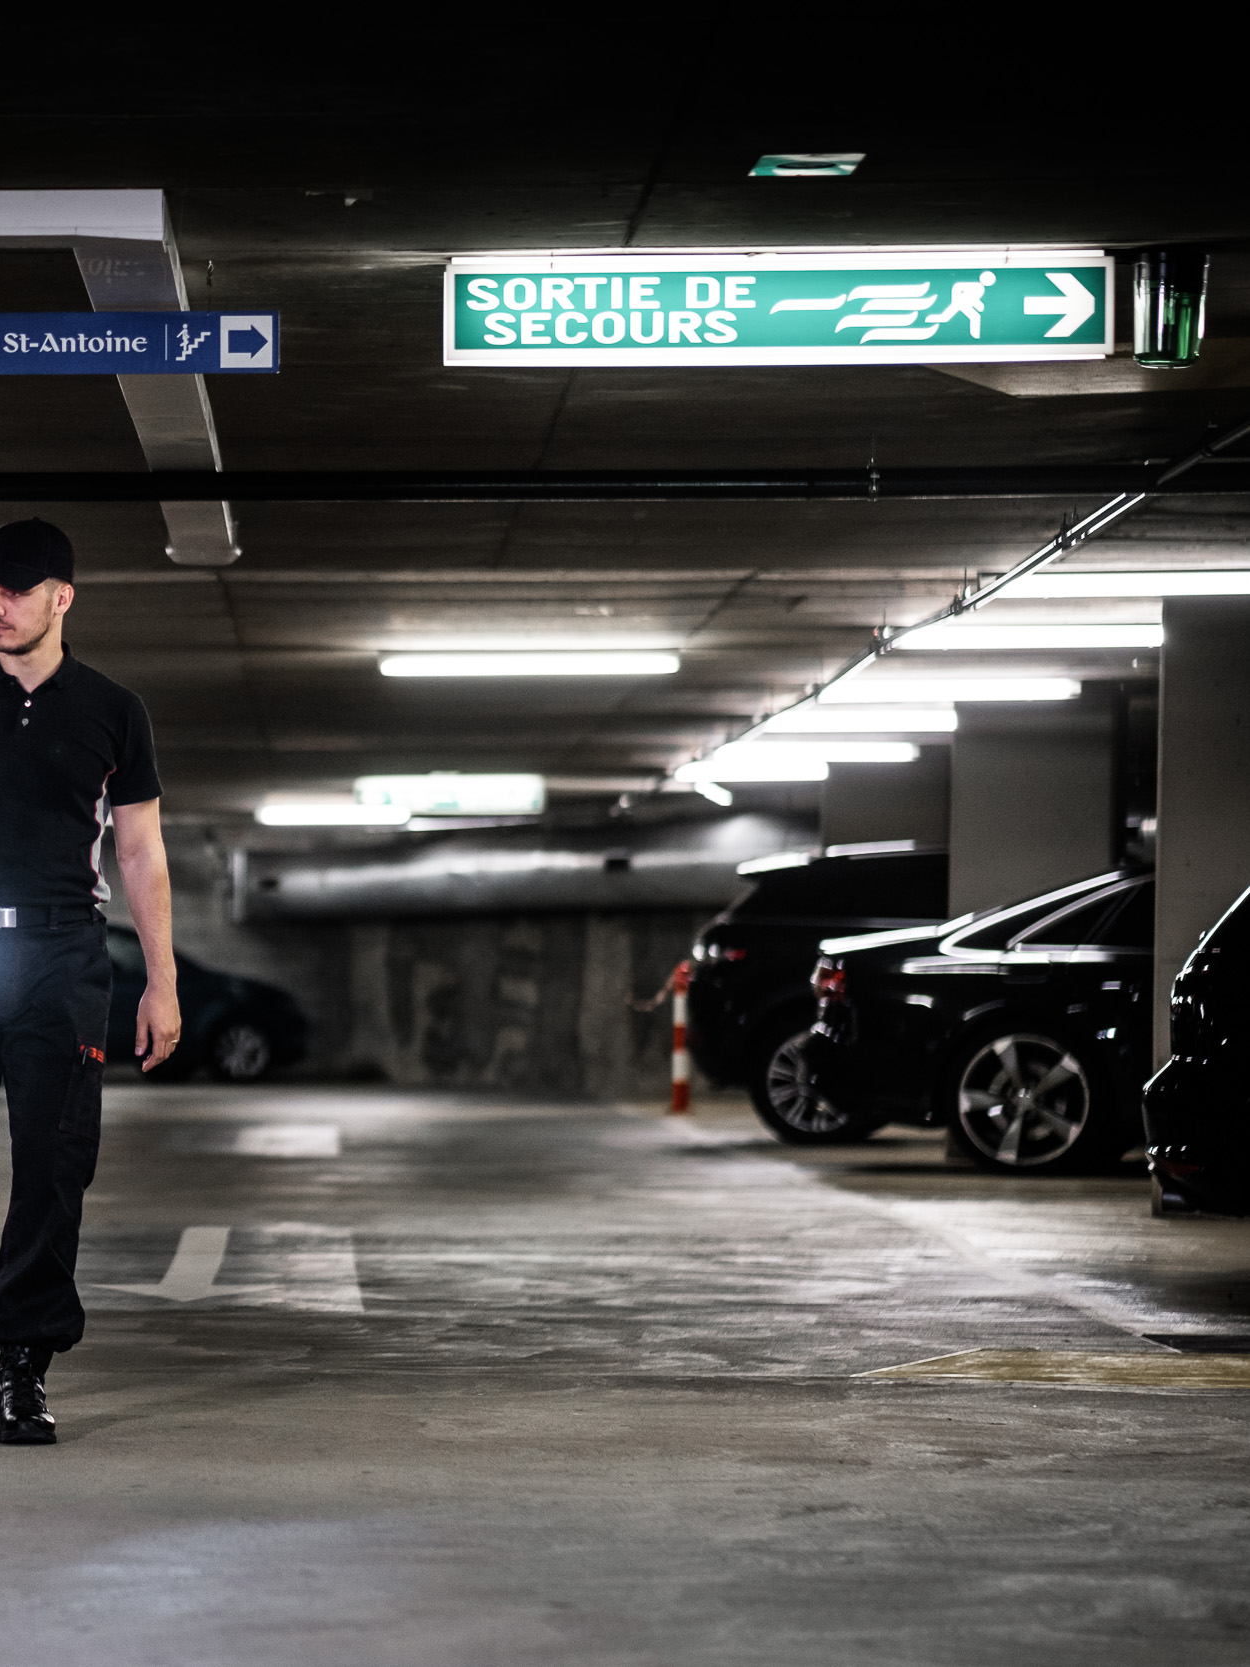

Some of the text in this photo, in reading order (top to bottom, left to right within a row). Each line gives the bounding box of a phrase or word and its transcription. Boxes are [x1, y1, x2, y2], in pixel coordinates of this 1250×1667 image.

[466, 275, 756, 310] SORTIE DE
[2, 330, 148, 354] St-Antoine
[483, 310, 738, 346] SECOURS
